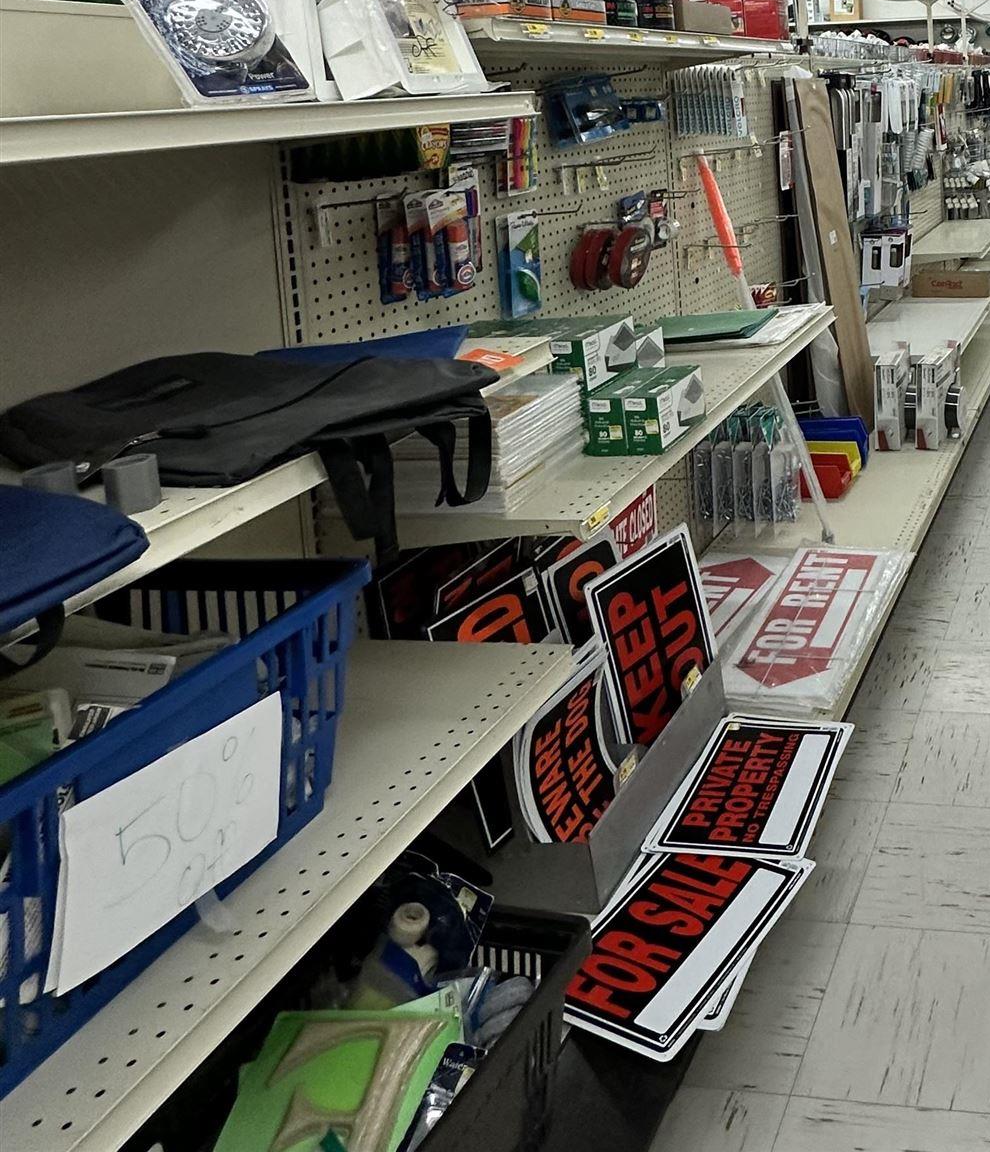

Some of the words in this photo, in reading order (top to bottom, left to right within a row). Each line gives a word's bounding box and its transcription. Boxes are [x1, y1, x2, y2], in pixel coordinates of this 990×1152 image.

[733, 95, 743, 136] VELCRO
[630, 494, 653, 546] CLOSED
[780, 553, 849, 608] RENT
[608, 591, 672, 746] KEEP
[650, 581, 704, 692] OUT
[747, 618, 817, 665] FOR
[535, 718, 585, 842] EWARE
[568, 737, 603, 806] THE
[682, 739, 752, 827] PRIVATE
[709, 732, 785, 842] PROPERTY
[742, 823, 760, 843] NO
[753, 733, 800, 818] TRESPASSING
[565, 930, 683, 1018] FOR
[628, 853, 752, 937] SALE
